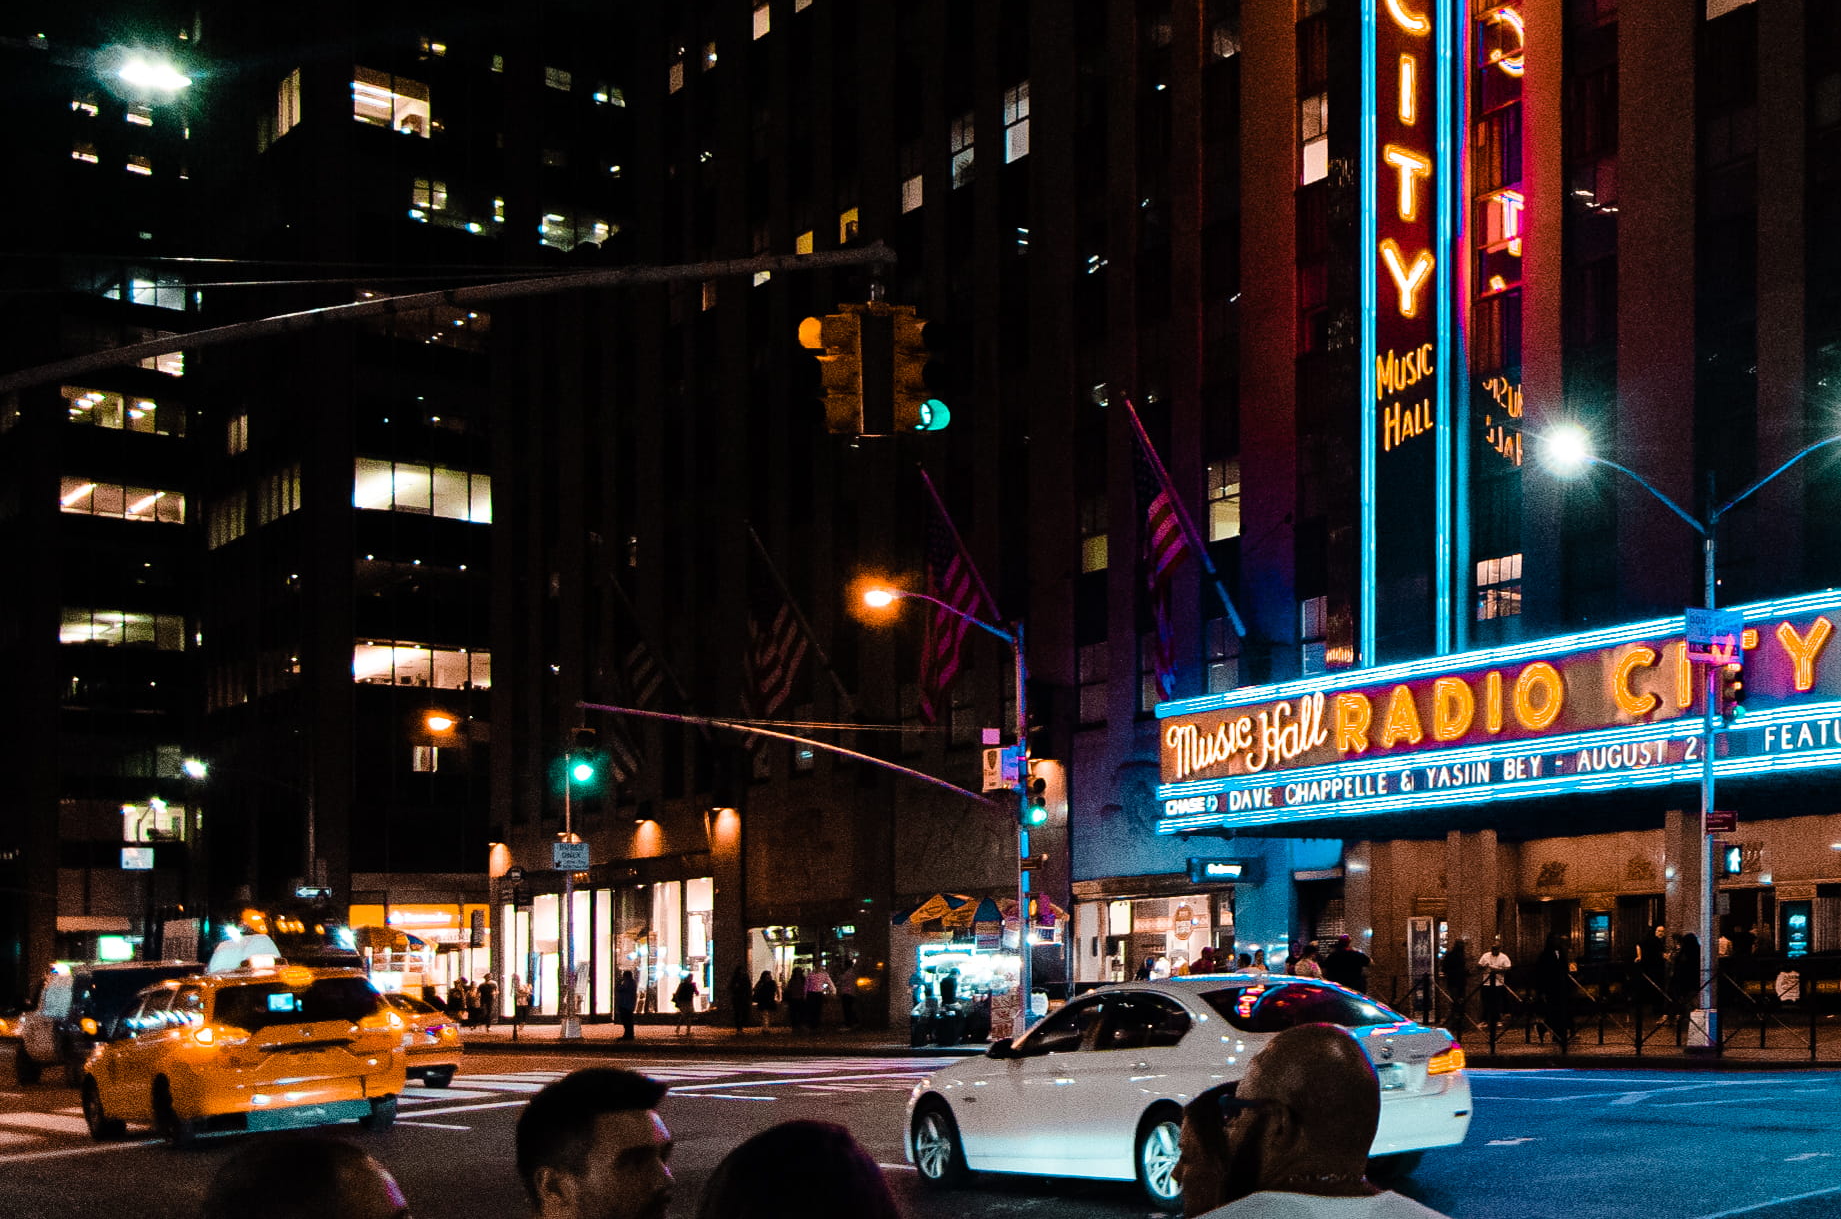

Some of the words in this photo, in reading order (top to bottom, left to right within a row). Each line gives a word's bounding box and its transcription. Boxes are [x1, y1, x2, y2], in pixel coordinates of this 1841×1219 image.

[1375, 342, 1435, 403] MUSIC
[1384, 398, 1434, 452] HALL
[1167, 716, 1252, 779] Music
[1246, 691, 1328, 773] Hall
[1336, 660, 1564, 754] RADIO
[1166, 796, 1206, 816] CHASE
[1229, 786, 1273, 812] DAVE
[1285, 773, 1387, 805] CHAPPELLE
[1400, 769, 1412, 792] &
[1426, 760, 1490, 790] YASIIN
[1503, 754, 1542, 781] BEY
[1577, 740, 1667, 773] AUGUST
